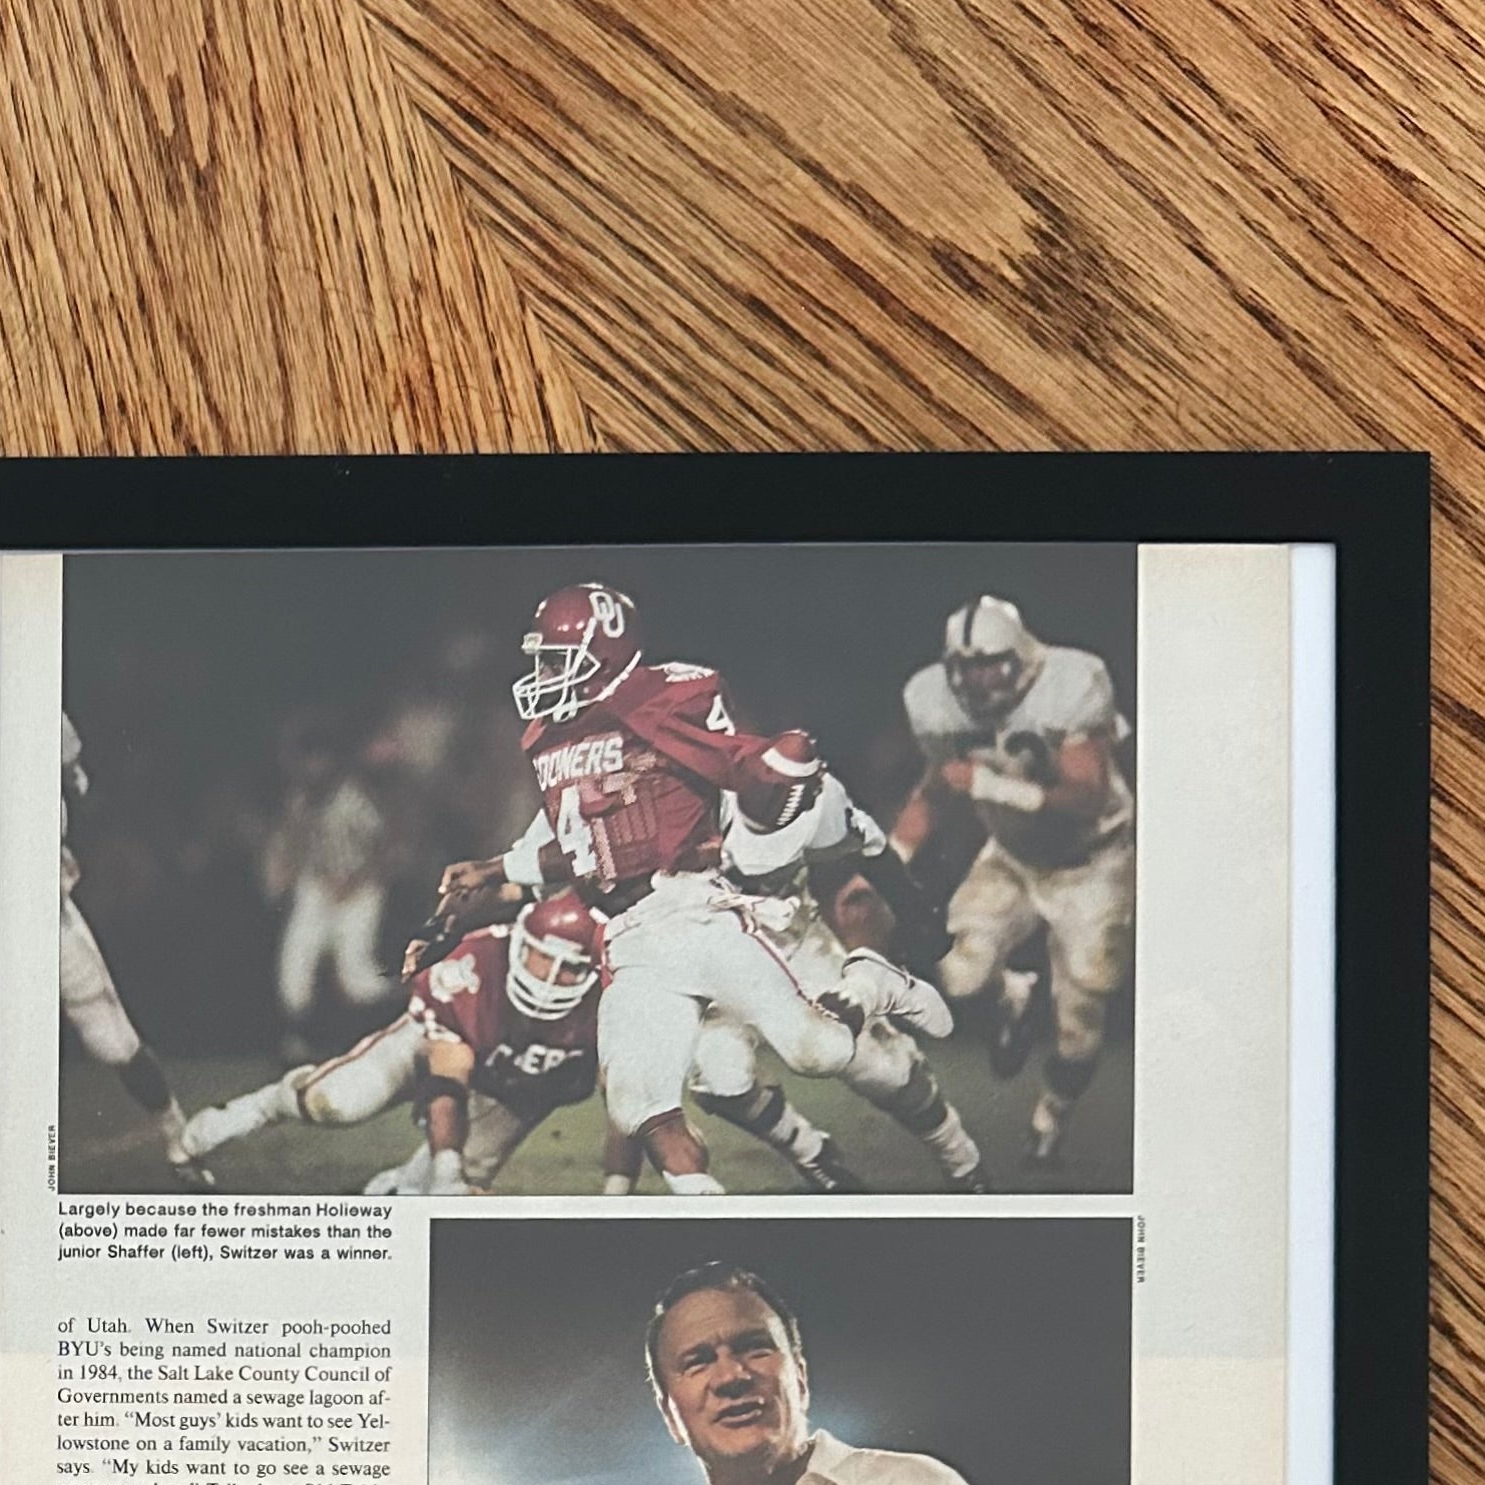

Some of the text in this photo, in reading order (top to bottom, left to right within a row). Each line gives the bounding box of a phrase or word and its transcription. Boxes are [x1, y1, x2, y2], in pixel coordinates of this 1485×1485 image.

[589, 591, 625, 638] OU
[706, 694, 736, 736] 4
[532, 736, 624, 792] OONERS
[59, 1201, 392, 1220] Largely because the freshman Holieway
[59, 1221, 392, 1240] (above) made far fewer mistakes than the
[1137, 1215, 1145, 1243] JOHN
[57, 1244, 392, 1263] junior Shaffer (left), Switzer was a winner.
[58, 1317, 391, 1338] of Utah. When Switzer pooh-poohed
[58, 1387, 391, 1409] Governments named a sewage lagoon af-
